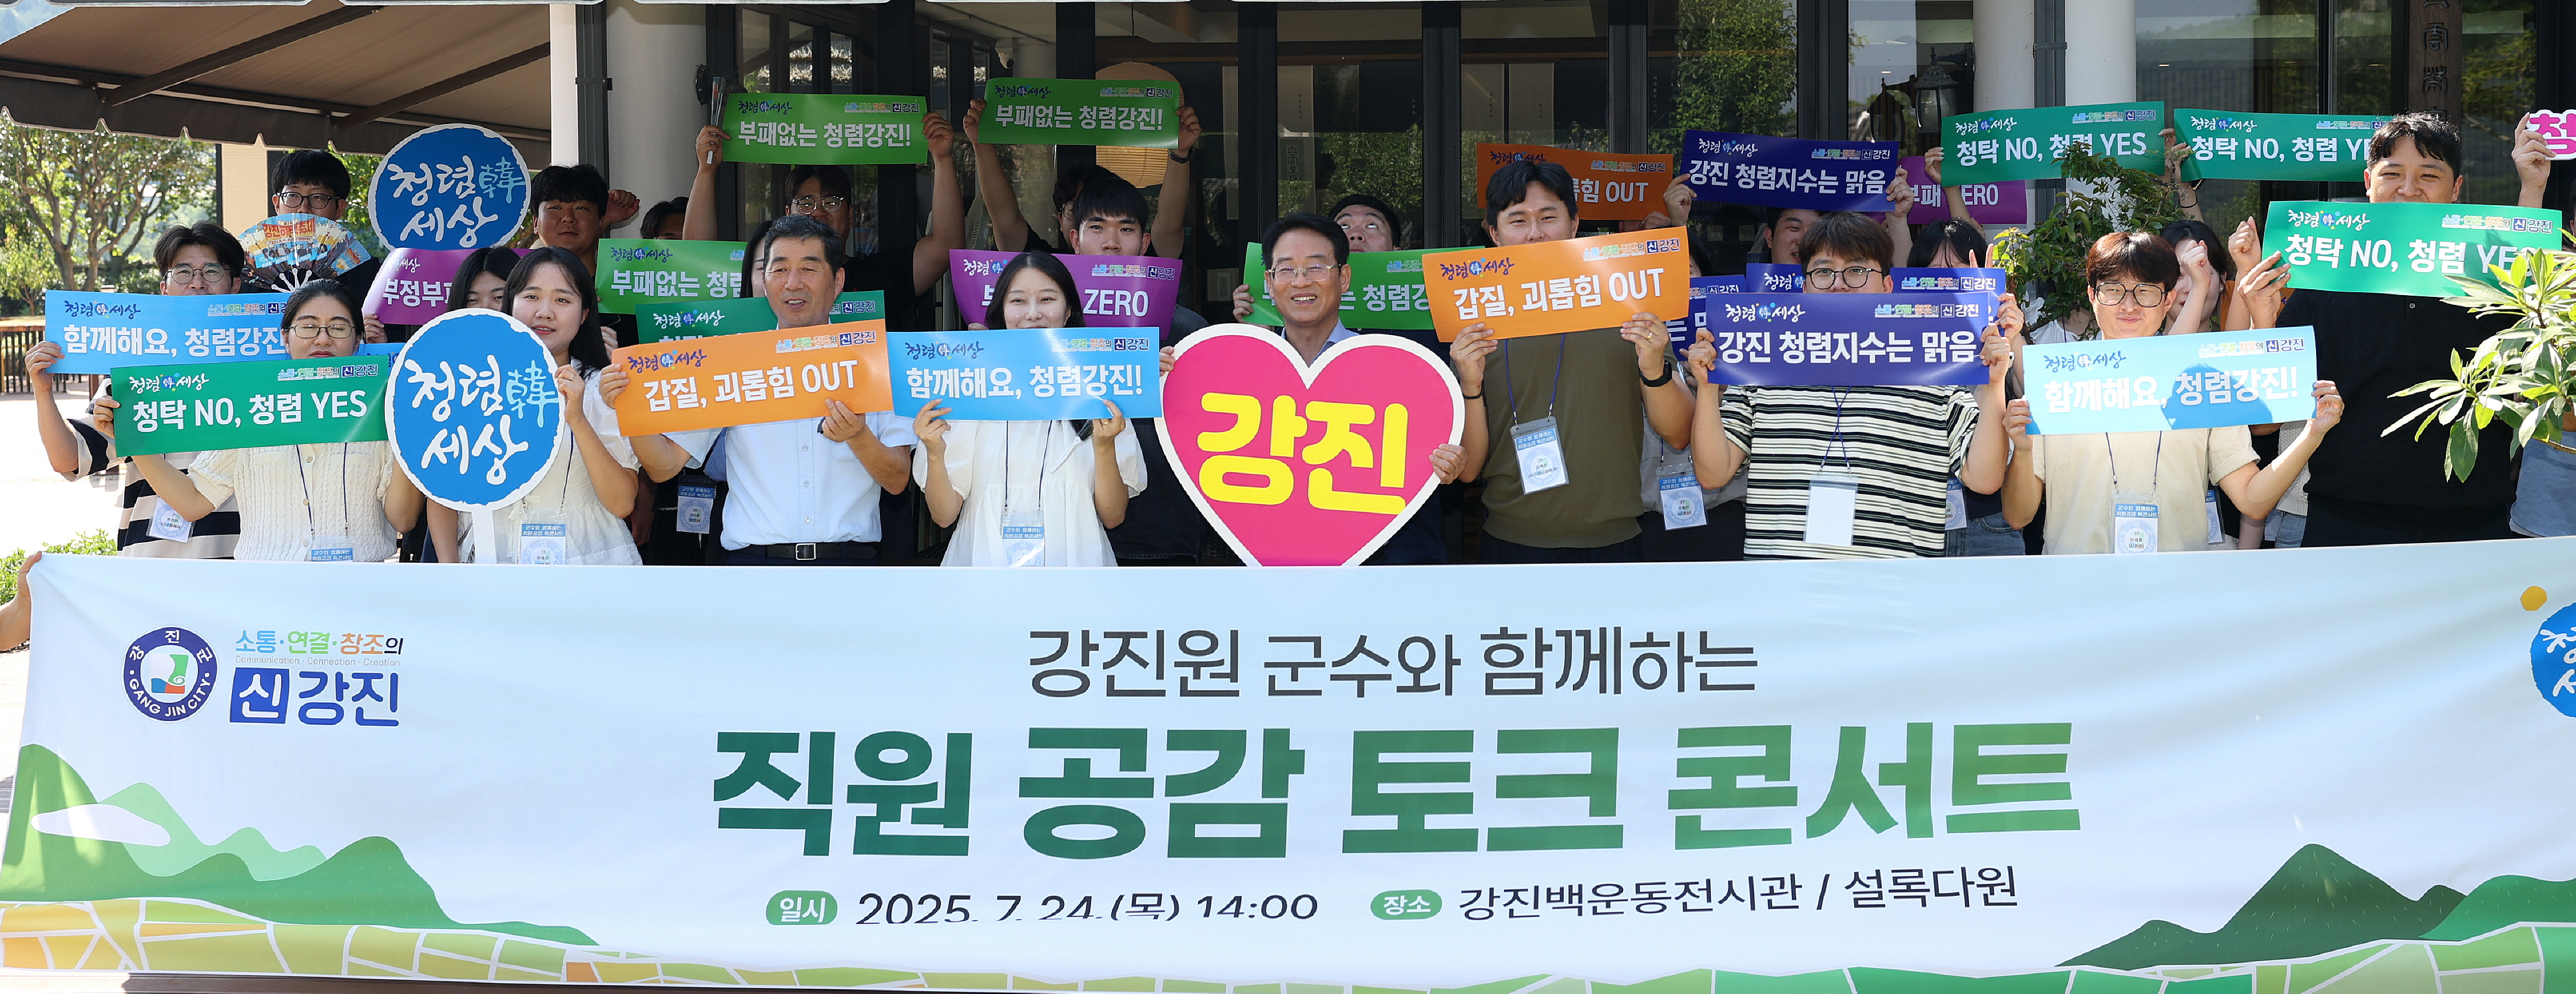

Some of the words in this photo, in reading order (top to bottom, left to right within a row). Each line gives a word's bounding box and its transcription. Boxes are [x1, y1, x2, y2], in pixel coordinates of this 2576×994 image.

[995, 105, 1073, 128] 부패없는
[1078, 106, 1163, 131] 청렴강진!
[738, 121, 817, 146] 부패없는
[824, 123, 911, 147] 청렴강진!
[1957, 138, 1999, 167] 청탁
[2005, 137, 2043, 162] NO,
[2100, 132, 2147, 157] YES
[2192, 136, 2238, 161] 청탁
[2245, 138, 2285, 162] NO,
[2292, 137, 2338, 162] 청렴
[1690, 160, 1729, 186] 강진
[1735, 164, 1839, 194] 청렴지수는
[1845, 169, 1886, 194] 맑음
[1606, 181, 1649, 202] OUT
[1960, 184, 1999, 206] ERO
[400, 196, 499, 248] 세상
[2512, 217, 2553, 234] 신강진
[1646, 238, 1681, 254] 신강진
[2285, 233, 2344, 269] 청탁
[2350, 240, 2398, 273] NO,
[2407, 240, 2466, 274] 청렴
[2476, 244, 2536, 276] YE
[611, 270, 700, 297] 부패없는
[1147, 266, 1175, 280] 신강진
[1960, 277, 1997, 290] 신강진
[842, 300, 876, 313] 신강진
[1083, 289, 1149, 317] ZERO
[1453, 284, 1516, 320] 갑질,
[1521, 274, 1602, 311] 괴롭힘
[1608, 268, 1664, 302] OUT
[1940, 303, 1979, 318] 신강진
[63, 324, 177, 357] 함께해요,
[185, 328, 287, 356] 청렴강진
[839, 331, 877, 347] 신강진
[1114, 338, 1149, 351] 신강진
[1719, 331, 1771, 363] 강진
[1779, 331, 1914, 363] 청렴지수는
[1922, 331, 1977, 363] 맑음
[2266, 338, 2304, 352] 신강진
[342, 364, 379, 377] 신강진
[906, 367, 1022, 400] 함께해요,
[1029, 365, 1142, 397] 청렴강진!
[643, 376, 707, 412] 갑질,
[713, 366, 796, 404] 괴롭힘
[801, 360, 857, 393] OUT
[2044, 376, 2168, 413] 함께해요,
[2175, 366, 2298, 406] 청렴강진!
[134, 398, 186, 432] 청탁
[195, 397, 241, 428] NO,
[249, 392, 301, 424] 청렴
[311, 390, 367, 419] YES
[421, 414, 529, 484] 세상
[1197, 392, 1409, 516] 강진
[235, 655, 300, 666] Communication
[307, 657, 356, 667] Connection
[363, 657, 401, 667] Creation
[1029, 628, 1240, 698] 강진원
[1263, 633, 1462, 698] 군수와
[1480, 625, 1755, 695] 함께하는
[129, 678, 161, 715] GANG
[165, 704, 186, 718] JIN
[188, 680, 213, 711] CITY
[713, 730, 973, 857] 직원
[1019, 726, 1306, 860] 공감
[1341, 727, 1624, 854] 토크
[1667, 722, 2082, 851] 콘서트
[778, 896, 827, 923] 일시
[855, 892, 980, 926] 2025.
[1196, 893, 1319, 920] 14:00
[1383, 894, 1432, 916] 장소
[1459, 873, 1803, 922] 강진백운동전시관
[1816, 874, 1829, 912] /
[1845, 865, 2018, 910] 설록다원
